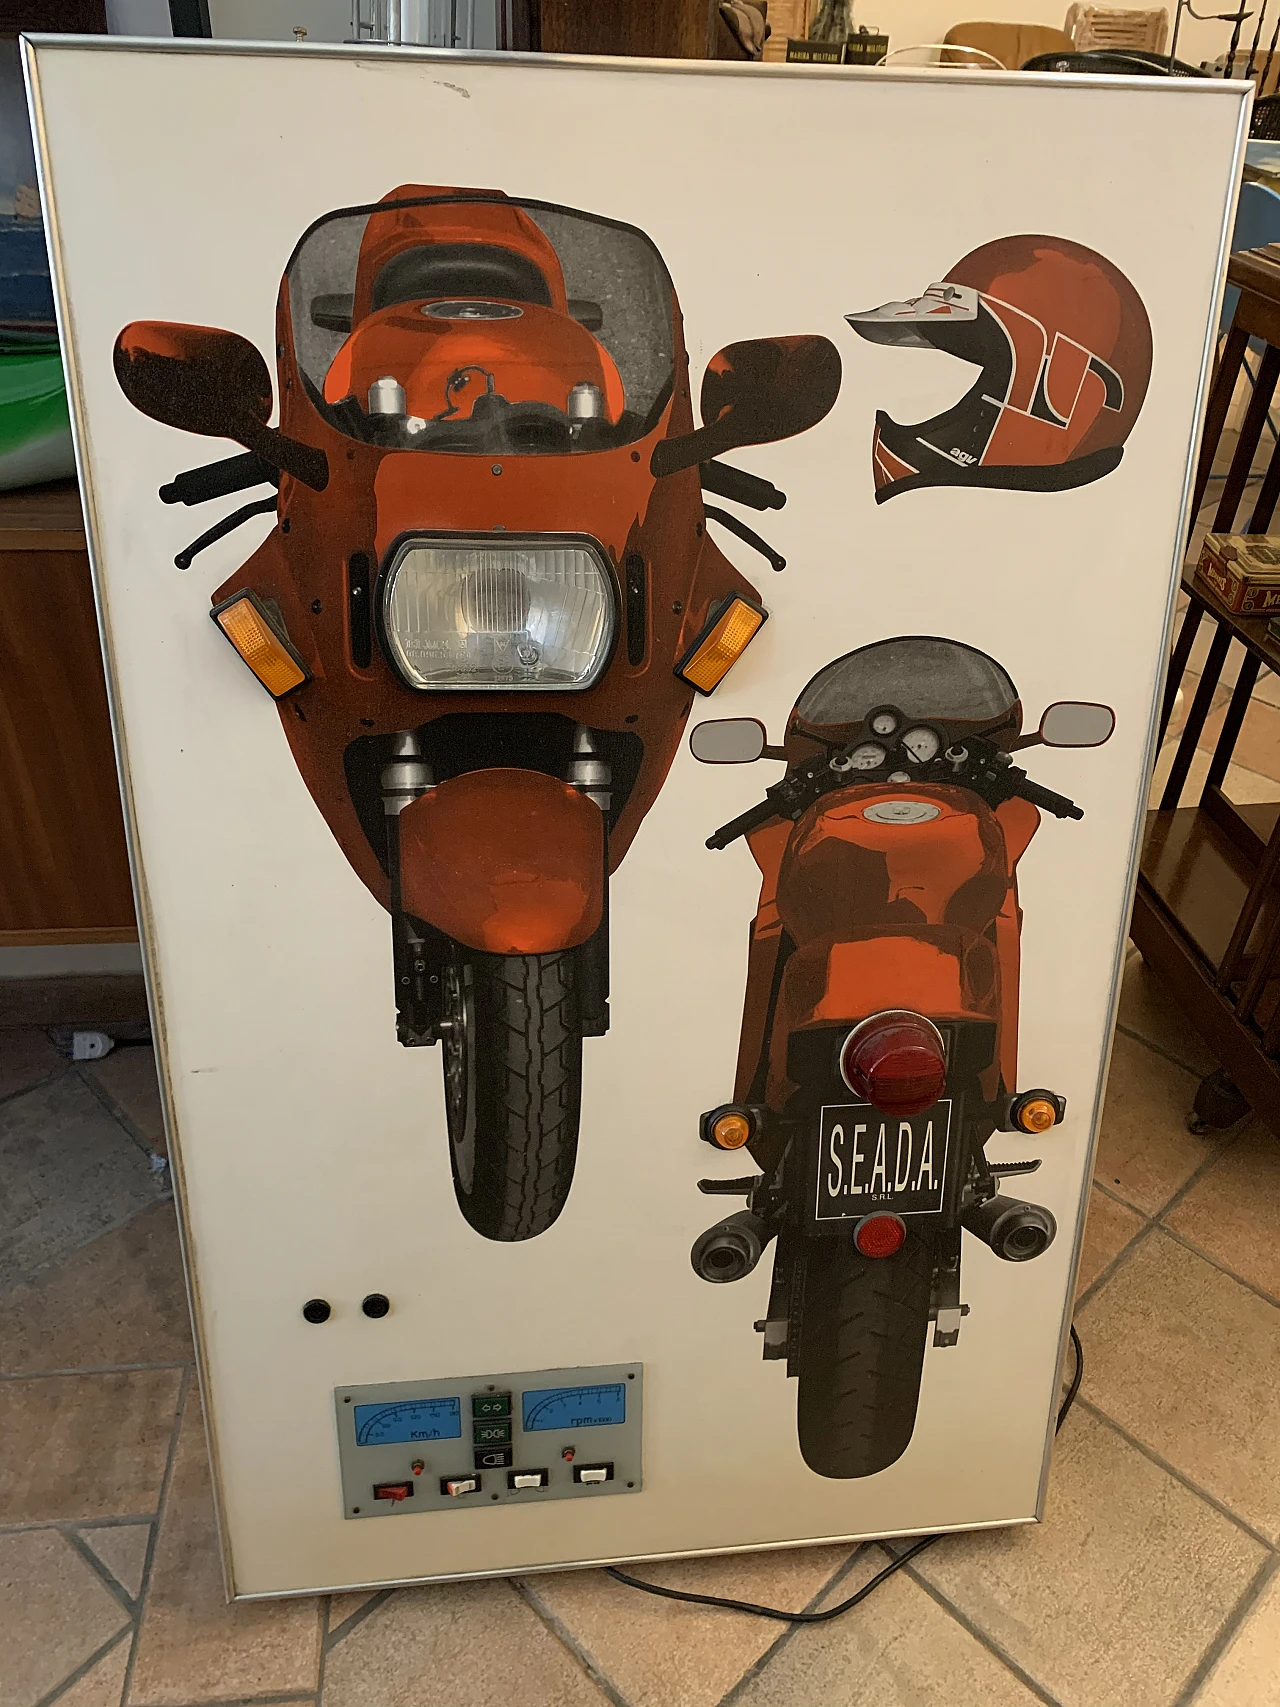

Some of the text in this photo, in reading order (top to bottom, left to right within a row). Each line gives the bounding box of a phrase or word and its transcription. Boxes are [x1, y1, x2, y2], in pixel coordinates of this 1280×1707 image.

[789, 51, 838, 61] MARINA MILITARE
[949, 447, 978, 465] agv
[827, 1120, 939, 1198] S.E.A.D.A.
[570, 1416, 593, 1427] rpm
[410, 1428, 441, 1439] Km/h
